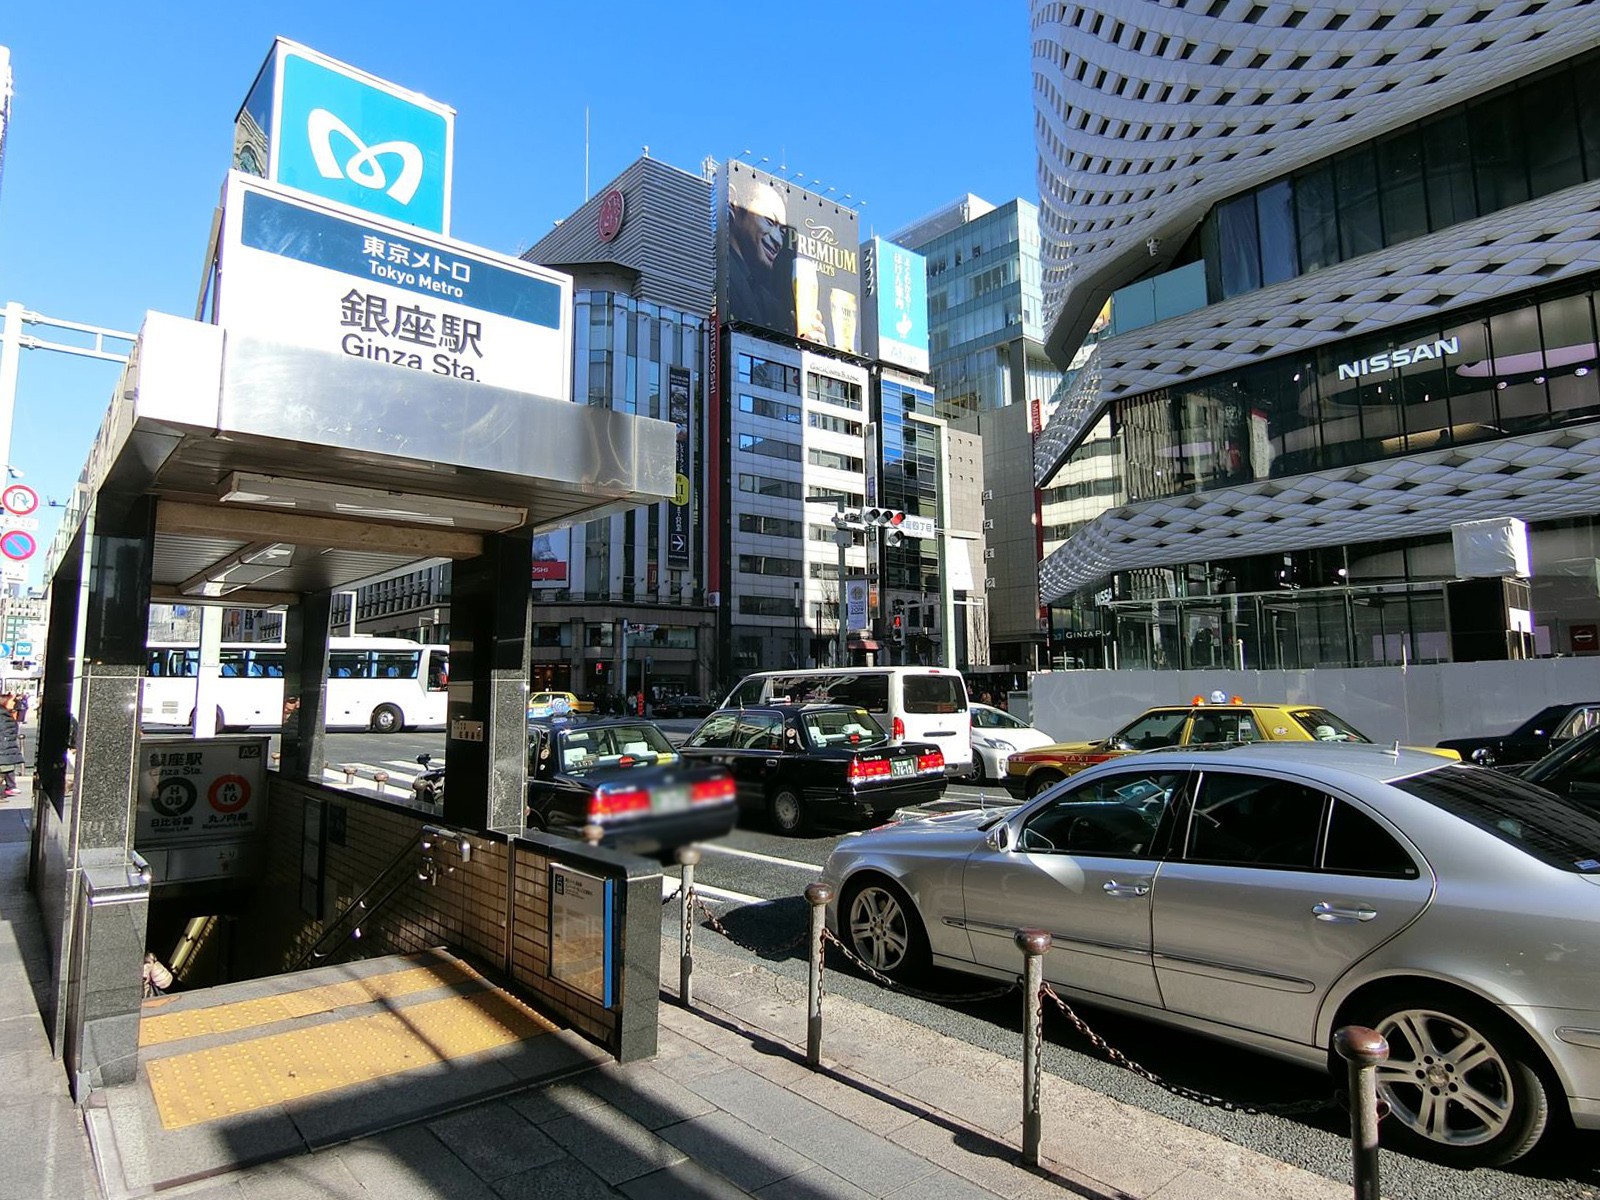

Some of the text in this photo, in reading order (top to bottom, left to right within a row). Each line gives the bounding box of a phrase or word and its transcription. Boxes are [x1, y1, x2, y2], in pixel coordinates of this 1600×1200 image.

[805, 218, 839, 246] The
[362, 234, 471, 283] 東京メトロ
[788, 227, 857, 274] PREMIUM
[368, 259, 464, 298] Tokyo Metro
[340, 288, 484, 359] 銀座駅
[341, 333, 481, 383] Ginza Sta.
[1338, 336, 1459, 380] NISSAN
[1065, 631, 1094, 639] GINZA
[150, 753, 203, 767] 銀座駅
[241, 747, 260, 758] A2
[182, 766, 203, 776] Sta.
[170, 786, 180, 795] H
[223, 793, 238, 802] 16
[224, 783, 236, 792] M
